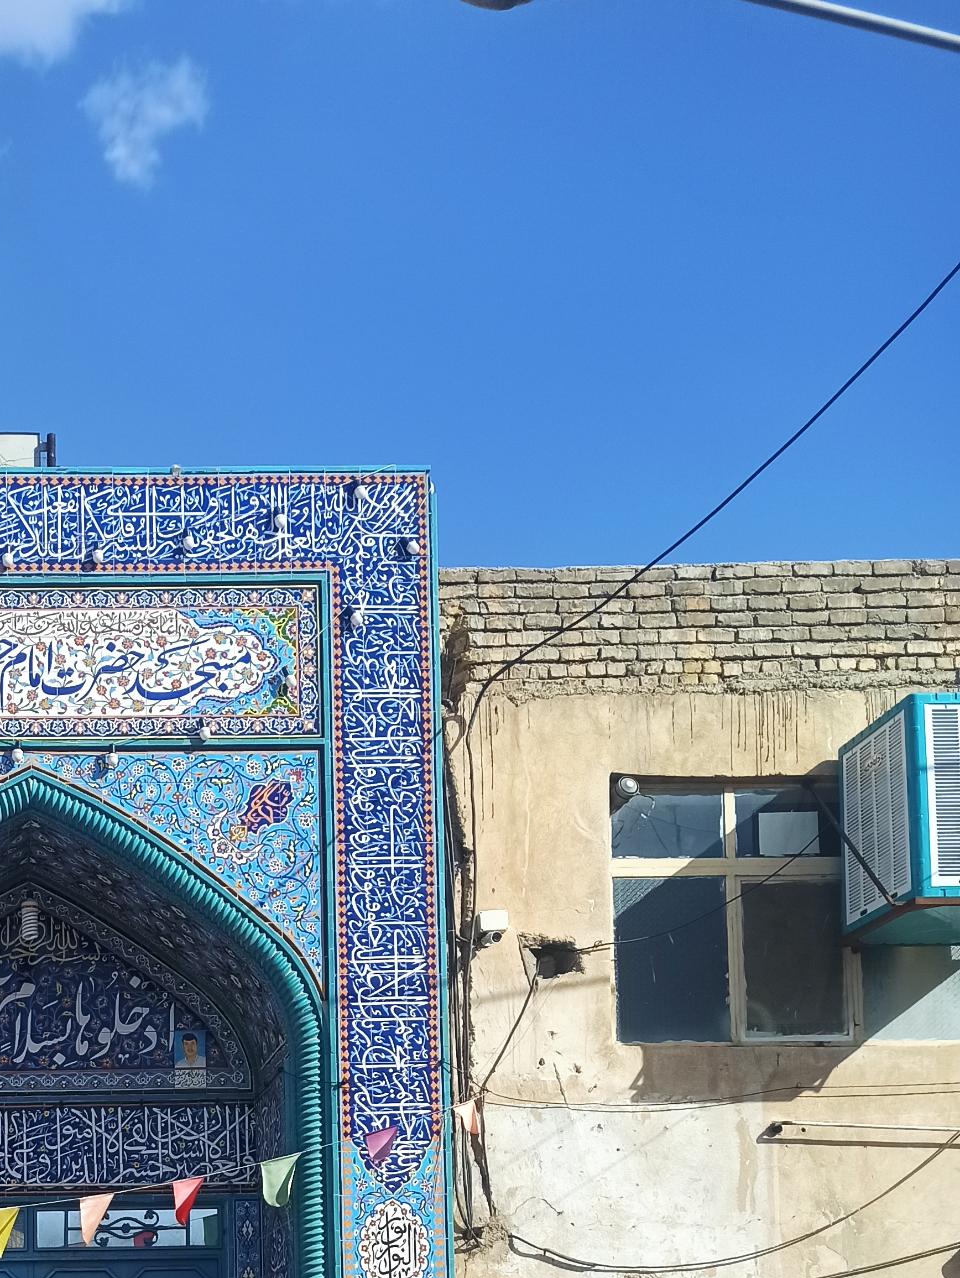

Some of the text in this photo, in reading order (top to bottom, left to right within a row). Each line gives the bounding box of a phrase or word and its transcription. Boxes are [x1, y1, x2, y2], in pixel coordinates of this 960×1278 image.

[0, 640, 54, 713] امام
[40, 640, 145, 701] حضرت
[122, 648, 252, 701] مسجد
